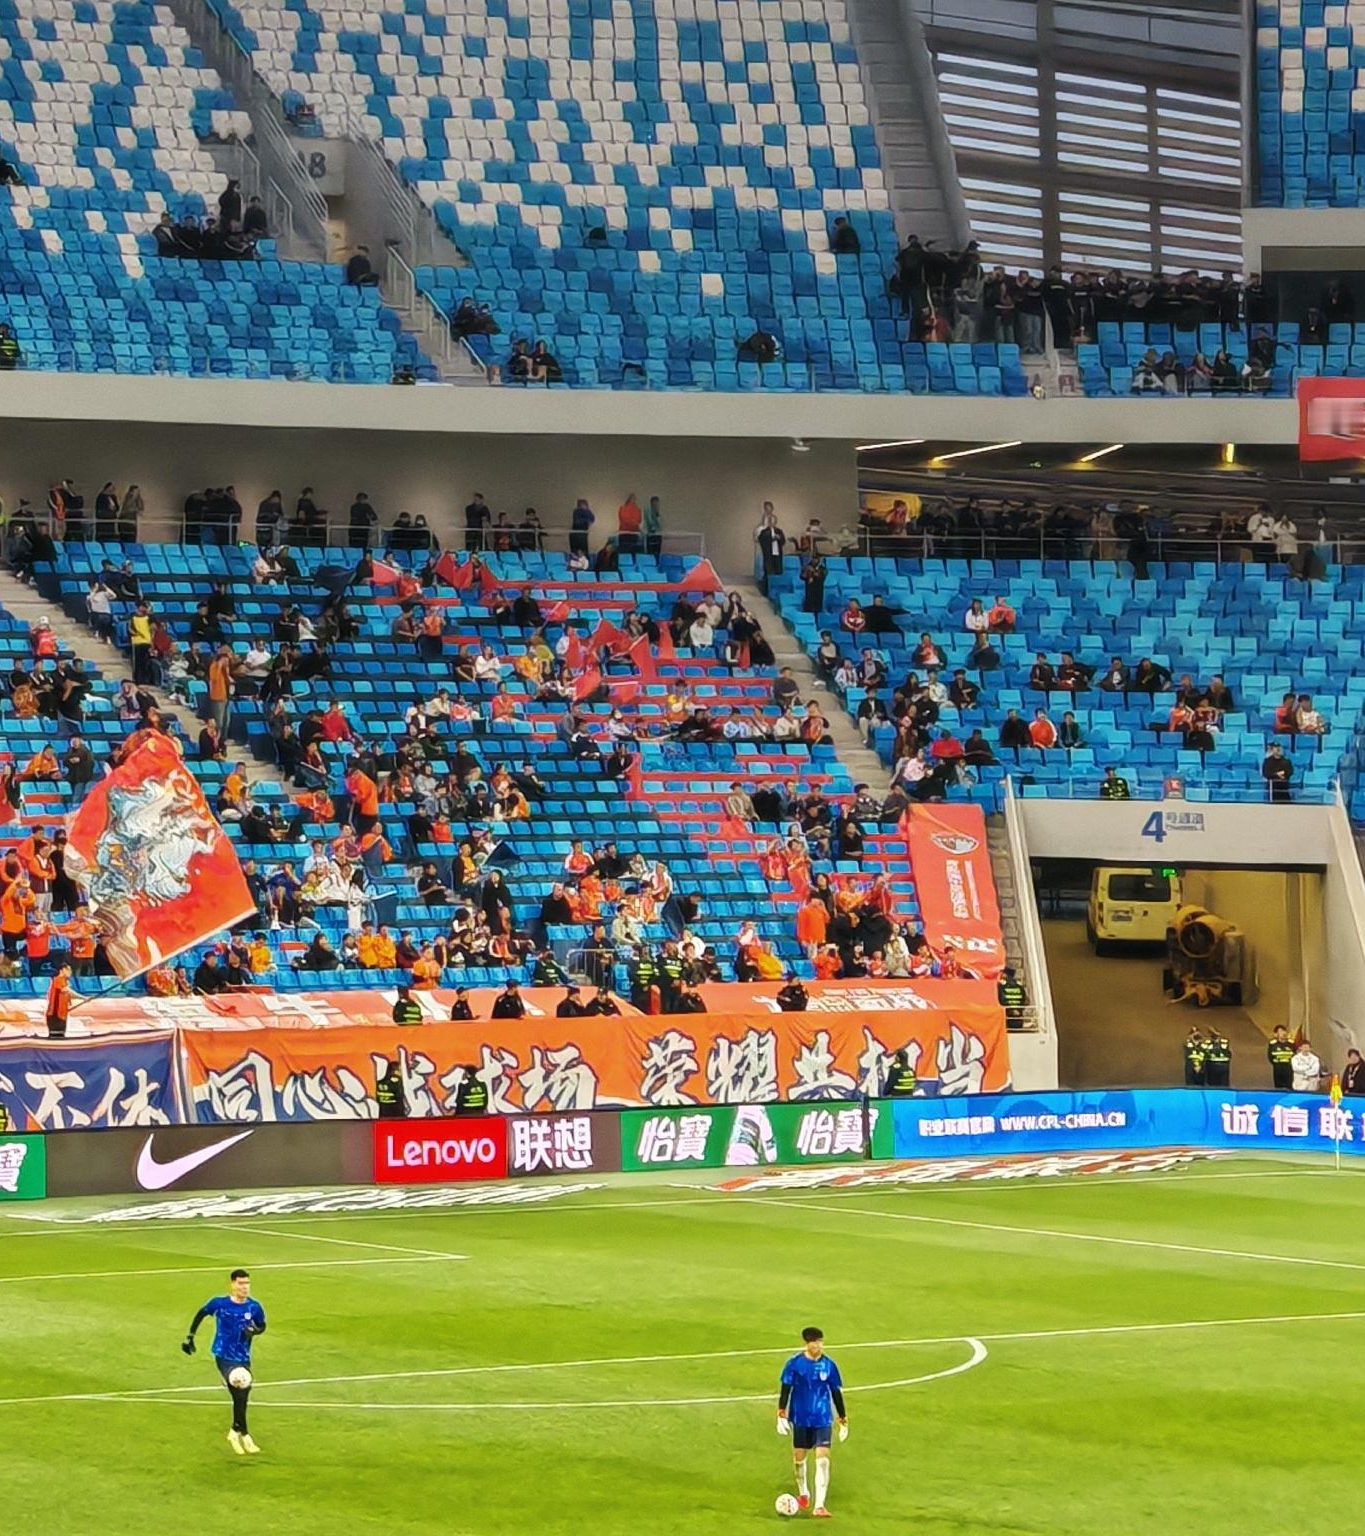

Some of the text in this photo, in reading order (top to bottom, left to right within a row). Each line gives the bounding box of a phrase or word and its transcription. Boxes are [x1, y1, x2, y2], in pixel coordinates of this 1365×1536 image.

[1141, 811, 1167, 842] 4
[1221, 1102, 1365, 1141] 诚信联
[387, 1135, 497, 1167] Lenovo
[511, 1116, 594, 1171] 联想
